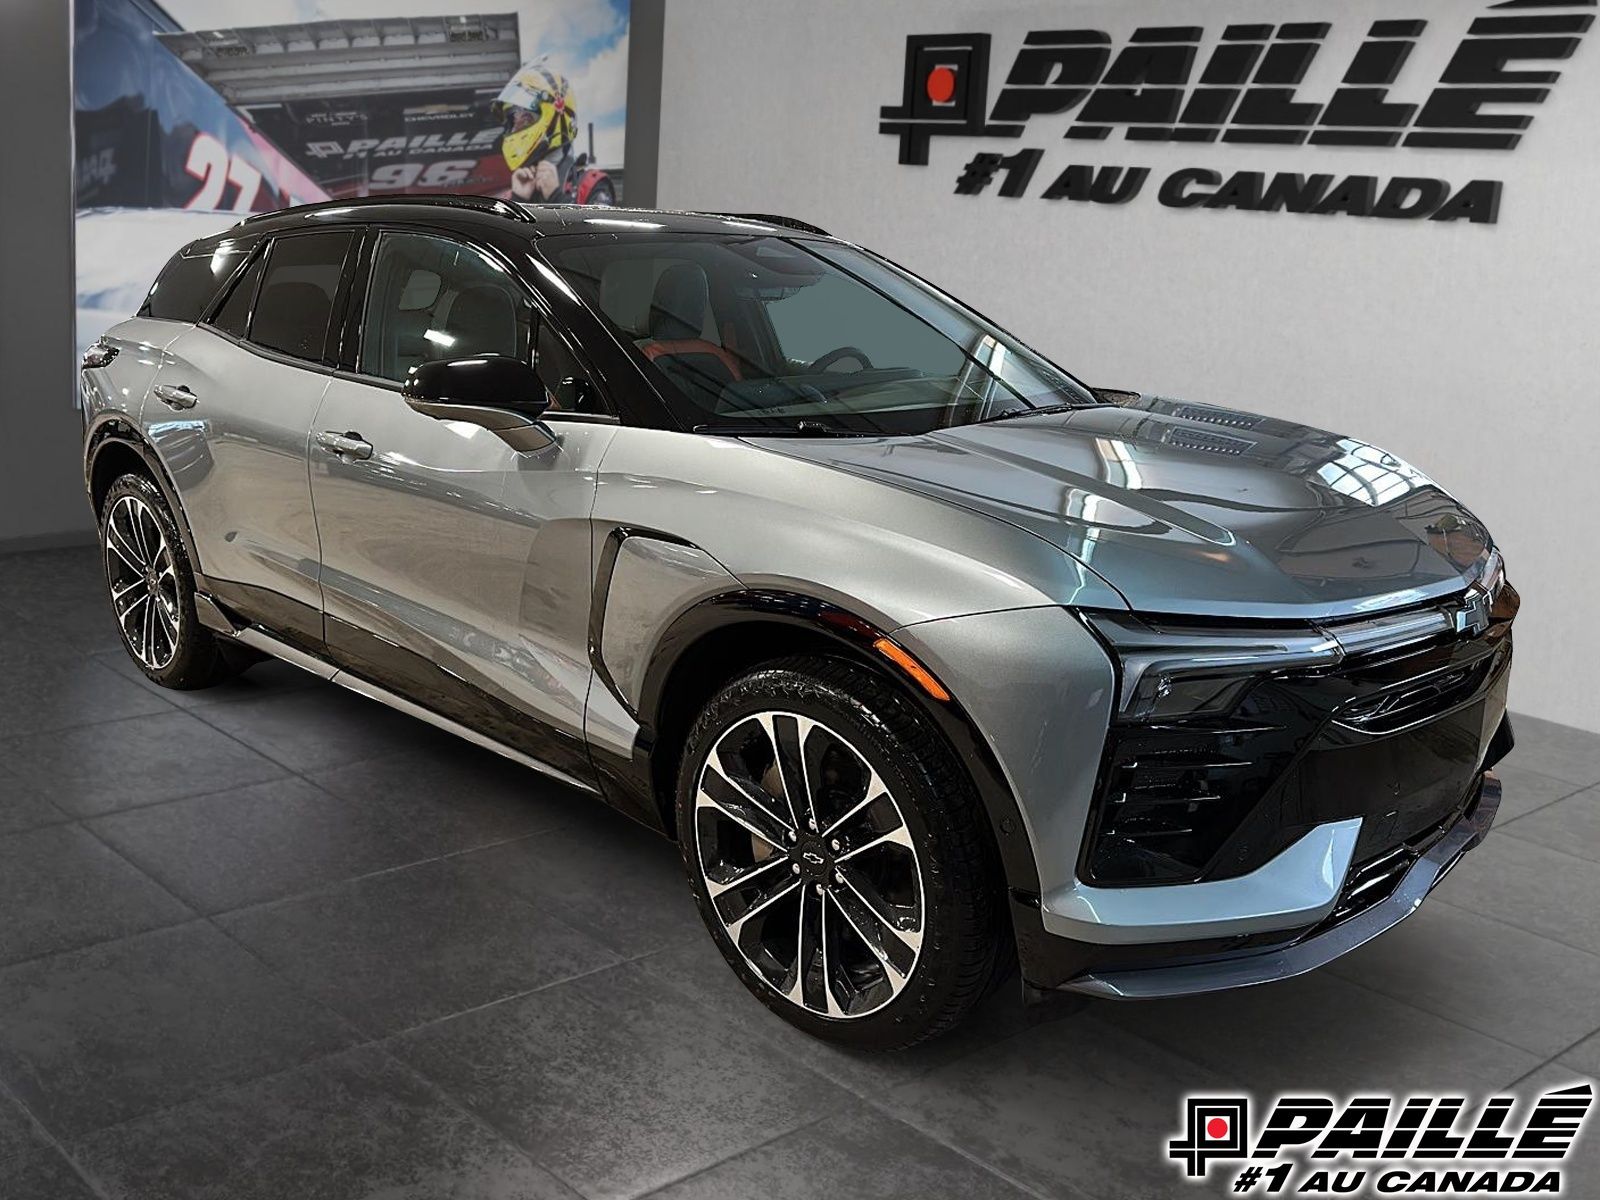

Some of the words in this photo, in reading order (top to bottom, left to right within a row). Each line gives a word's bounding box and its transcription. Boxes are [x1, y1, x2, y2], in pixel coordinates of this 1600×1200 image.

[985, 0, 1598, 150] PAILLÉ
[369, 159, 478, 190] 96
[953, 148, 1046, 198] #1
[1039, 165, 1152, 204] AU
[1157, 168, 1504, 225] CANADA
